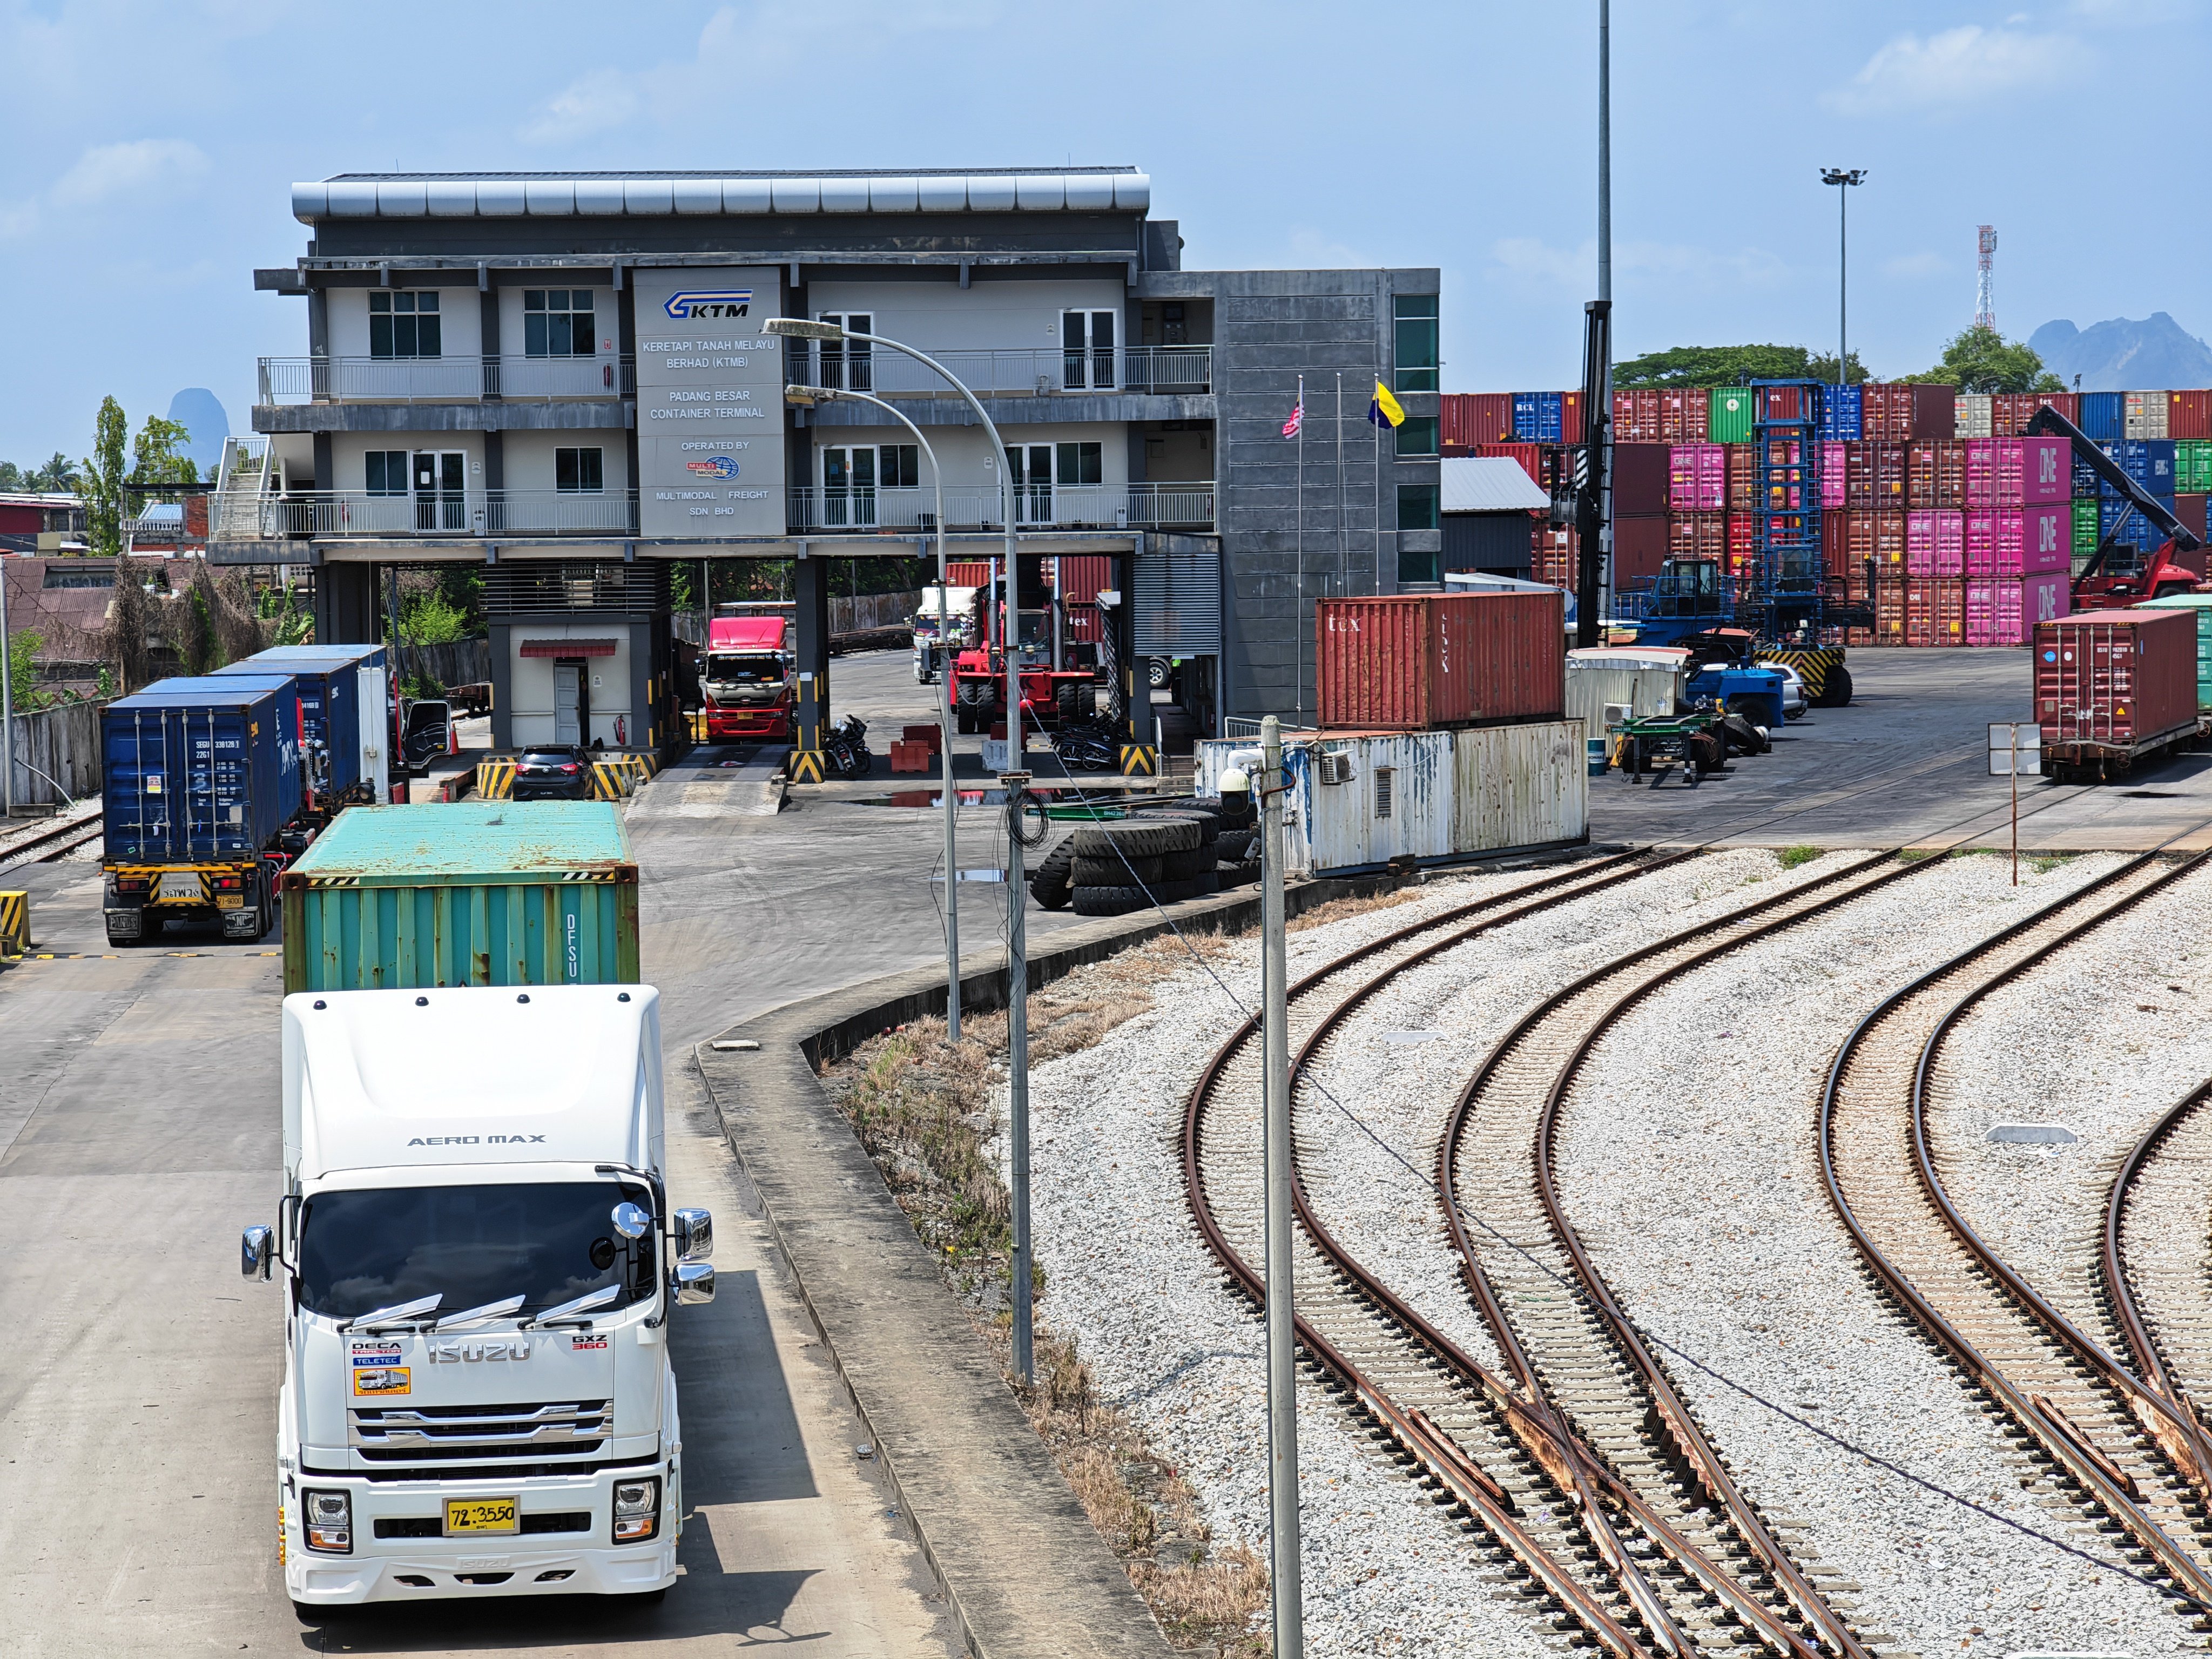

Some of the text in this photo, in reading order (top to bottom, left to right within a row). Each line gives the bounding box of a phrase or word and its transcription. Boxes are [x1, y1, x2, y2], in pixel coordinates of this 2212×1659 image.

[691, 304, 750, 318] KTM
[643, 340, 775, 352] KERETAPI TANAH MELAYU
[666, 356, 748, 368] BERHAD (KTMB)
[670, 390, 750, 402] PADANG BESAR
[650, 407, 765, 419] CONTAINER TERMINAL
[1516, 403, 1534, 412] RCL
[681, 441, 750, 451] OPERATED BY
[2040, 448, 2056, 483] ONE
[656, 491, 768, 501] MULTIMODAL FREIGHT
[689, 507, 734, 516] SDN BHD
[2039, 516, 2056, 552] ONE
[2039, 584, 2056, 621] ONE
[1069, 616, 1089, 626] tex
[567, 914, 577, 977] DFSU
[406, 1135, 547, 1147] AERO MAX
[572, 1342, 608, 1350] 360
[429, 1341, 531, 1364] ISUZU
